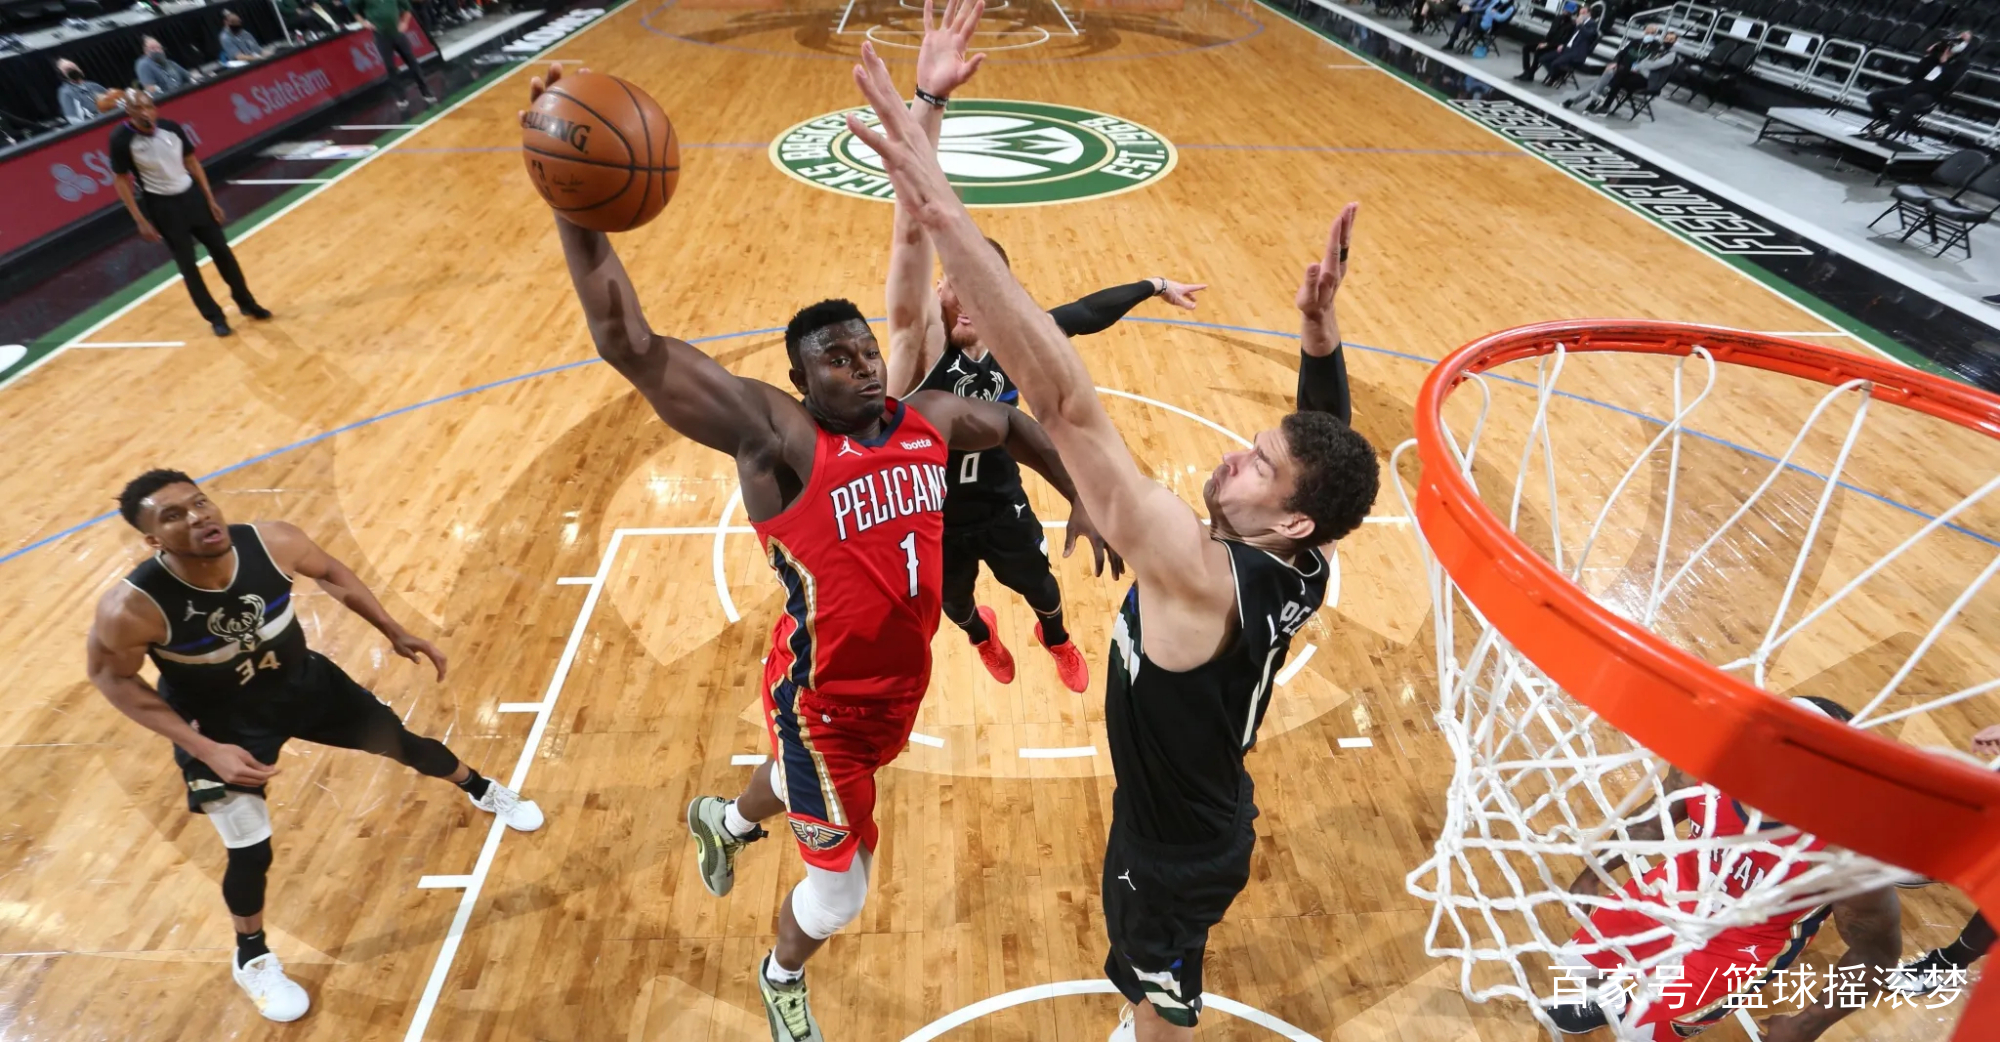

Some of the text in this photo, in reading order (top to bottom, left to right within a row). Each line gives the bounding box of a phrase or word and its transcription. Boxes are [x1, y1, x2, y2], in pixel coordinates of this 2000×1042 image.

[1077, 116, 1165, 180] EST. 1968
[1524, 143, 1659, 182] THE
[1601, 184, 1813, 255] FEAR
[960, 452, 981, 484] 0
[899, 531, 920, 598] 1
[235, 651, 281, 686] 34
